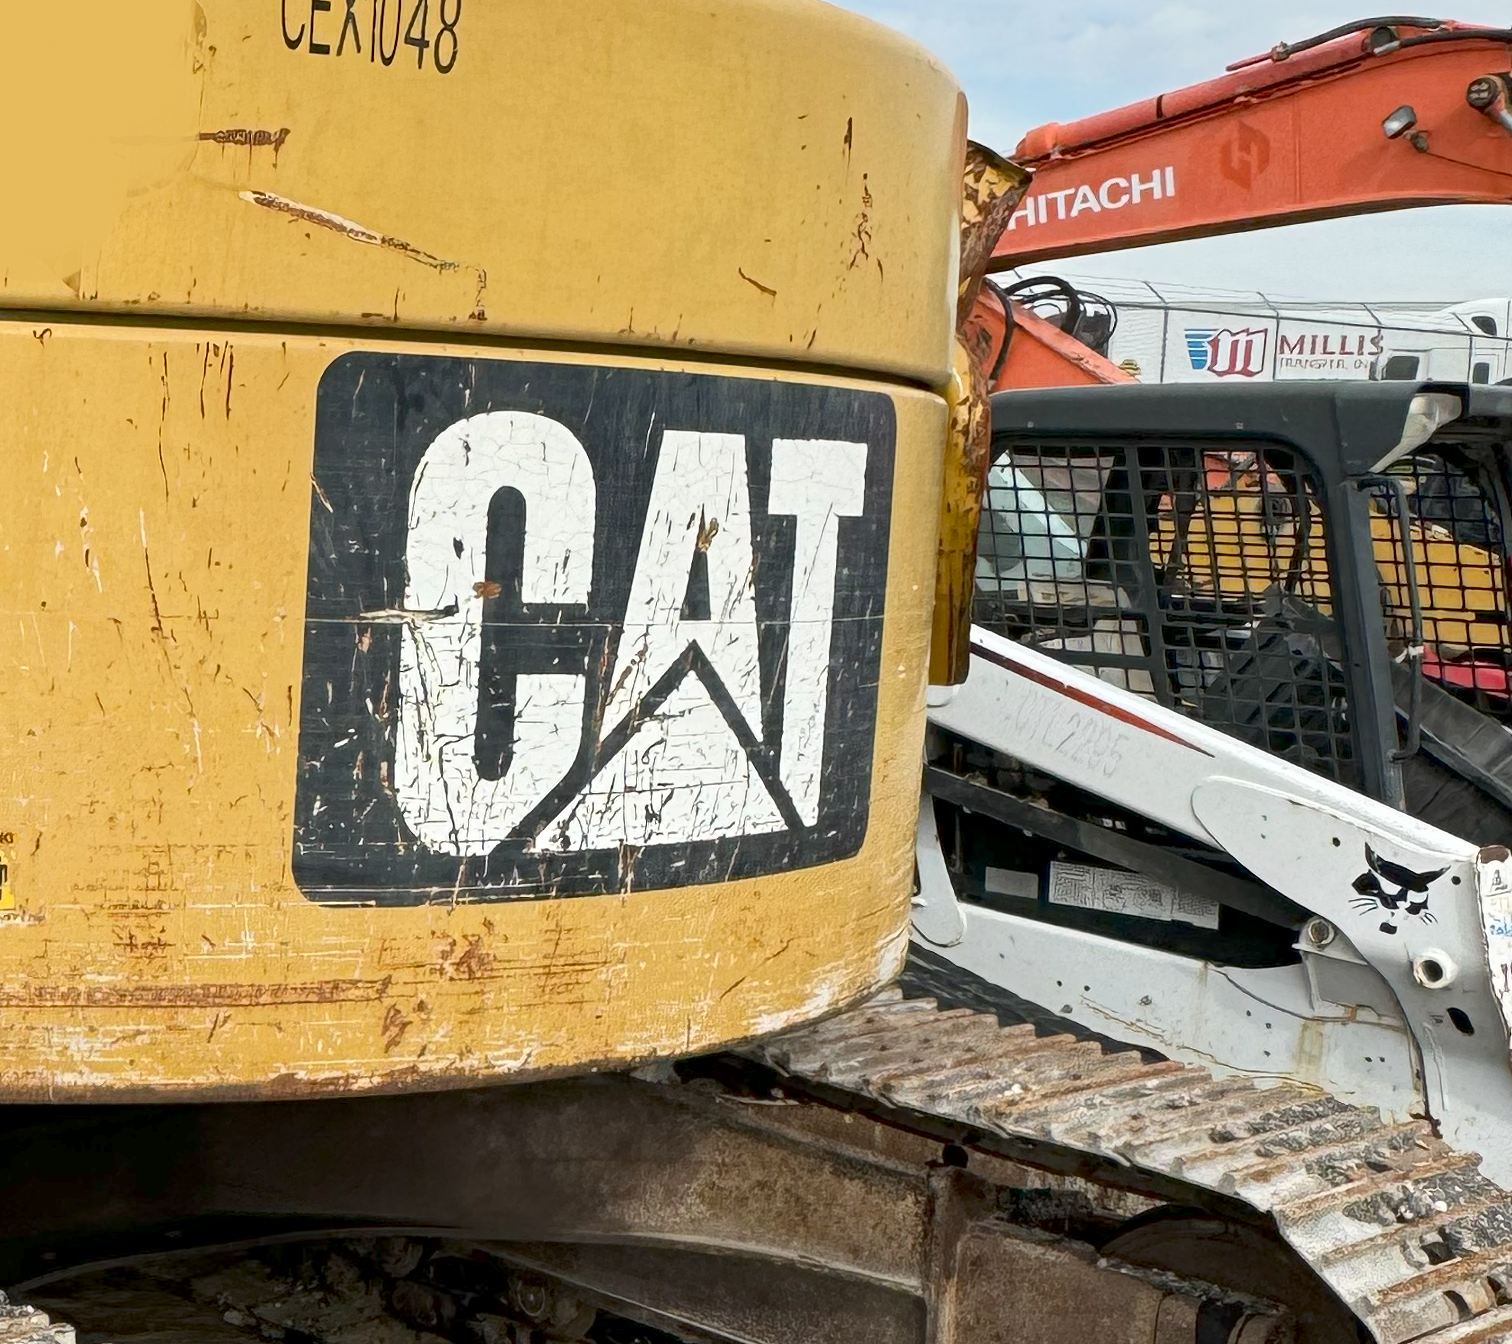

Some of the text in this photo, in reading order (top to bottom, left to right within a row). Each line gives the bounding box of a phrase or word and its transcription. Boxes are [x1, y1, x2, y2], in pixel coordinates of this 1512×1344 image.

[1007, 166, 1176, 230] HITACHI
[1279, 333, 1383, 355] MILLIS
[394, 410, 869, 856] CAT
